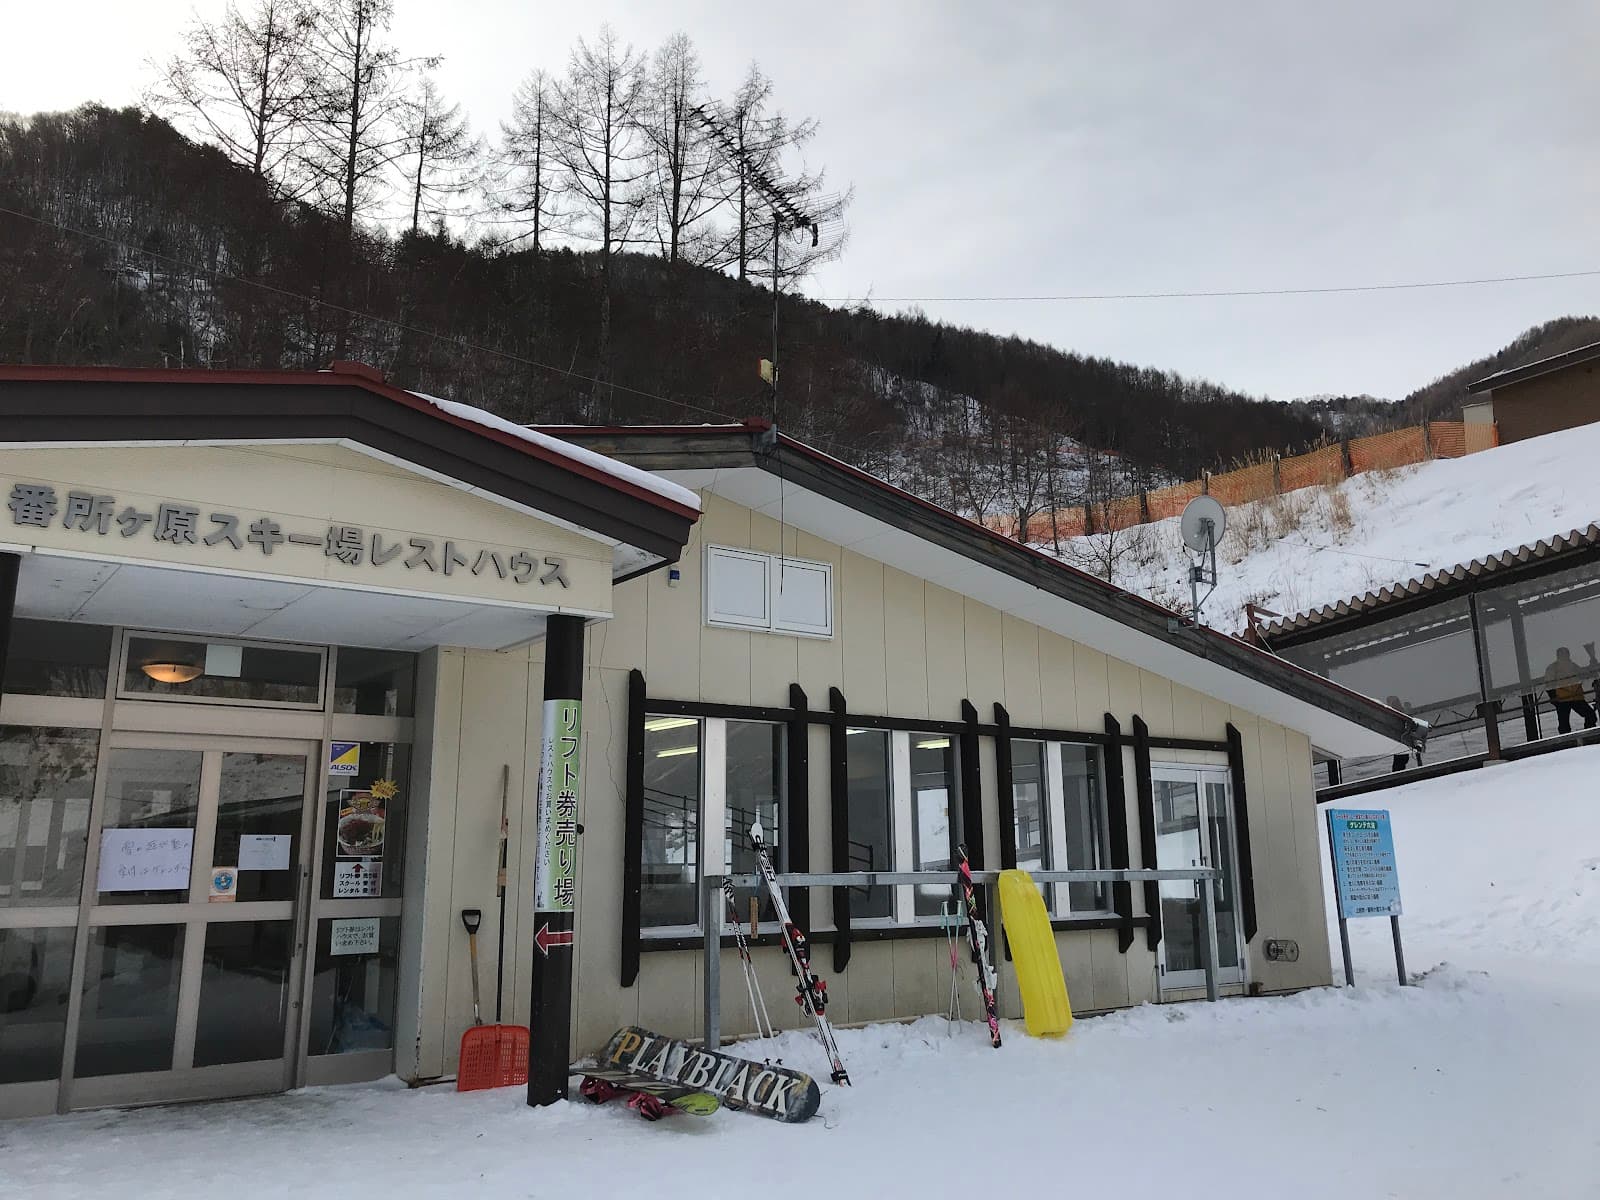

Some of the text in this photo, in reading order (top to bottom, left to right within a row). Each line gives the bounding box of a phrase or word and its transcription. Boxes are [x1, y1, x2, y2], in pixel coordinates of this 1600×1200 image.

[554, 708, 579, 907] リフト券売り場
